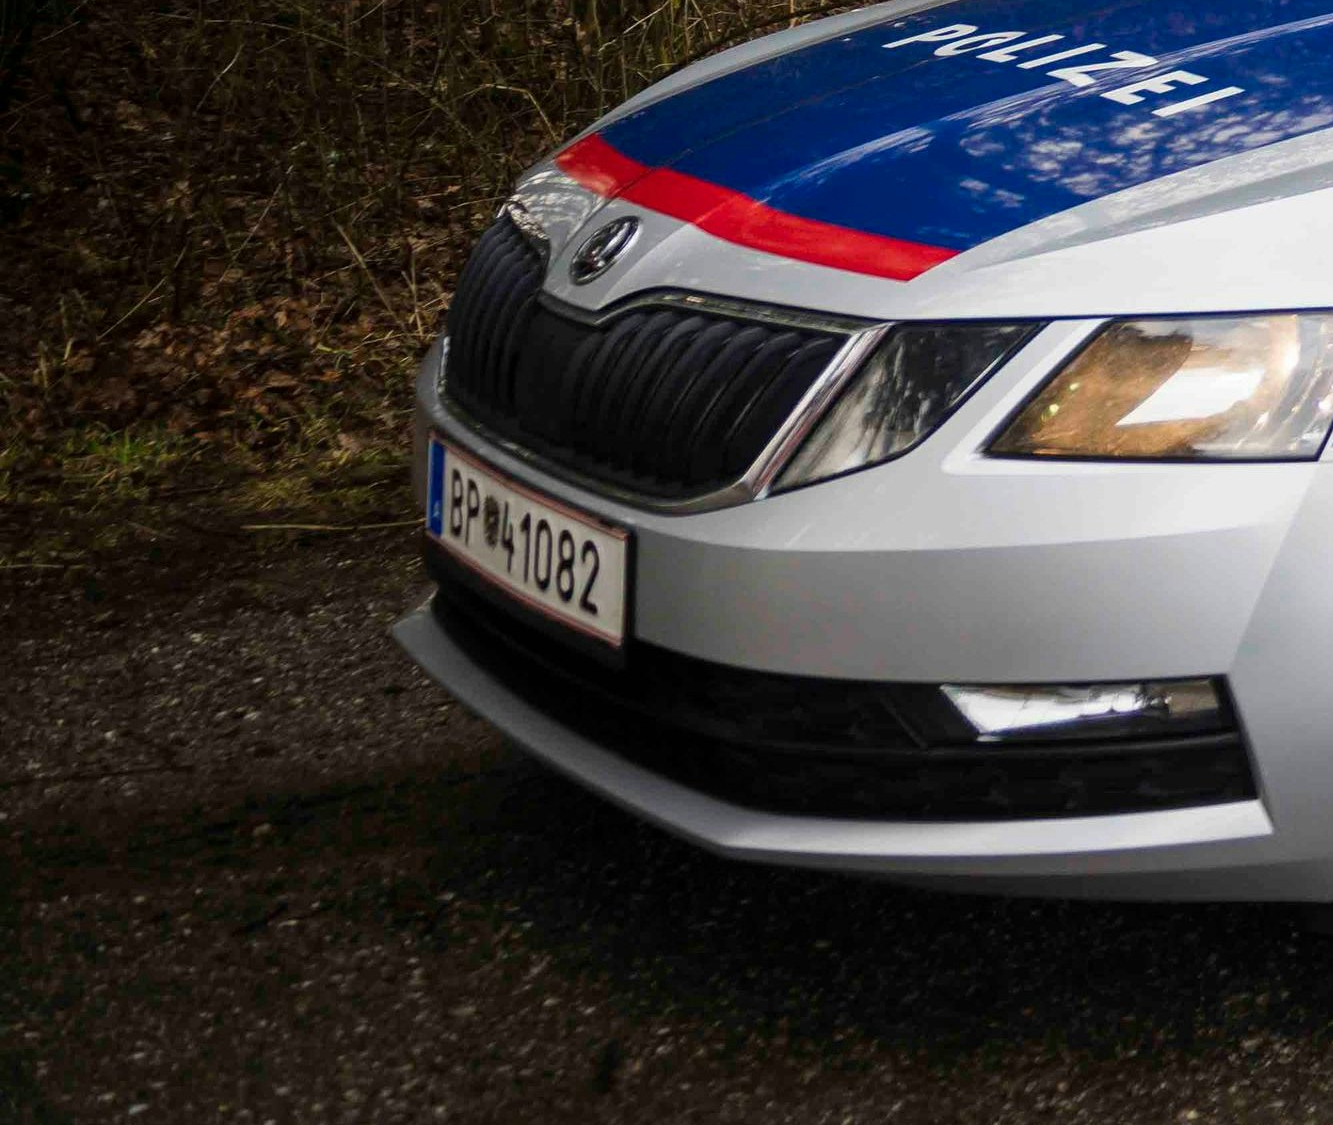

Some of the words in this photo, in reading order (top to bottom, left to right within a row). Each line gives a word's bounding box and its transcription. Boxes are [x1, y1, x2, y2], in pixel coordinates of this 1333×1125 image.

[881, 23, 1246, 118] POLIZEI
[450, 469, 480, 546] BP
[501, 500, 601, 615] 41082
